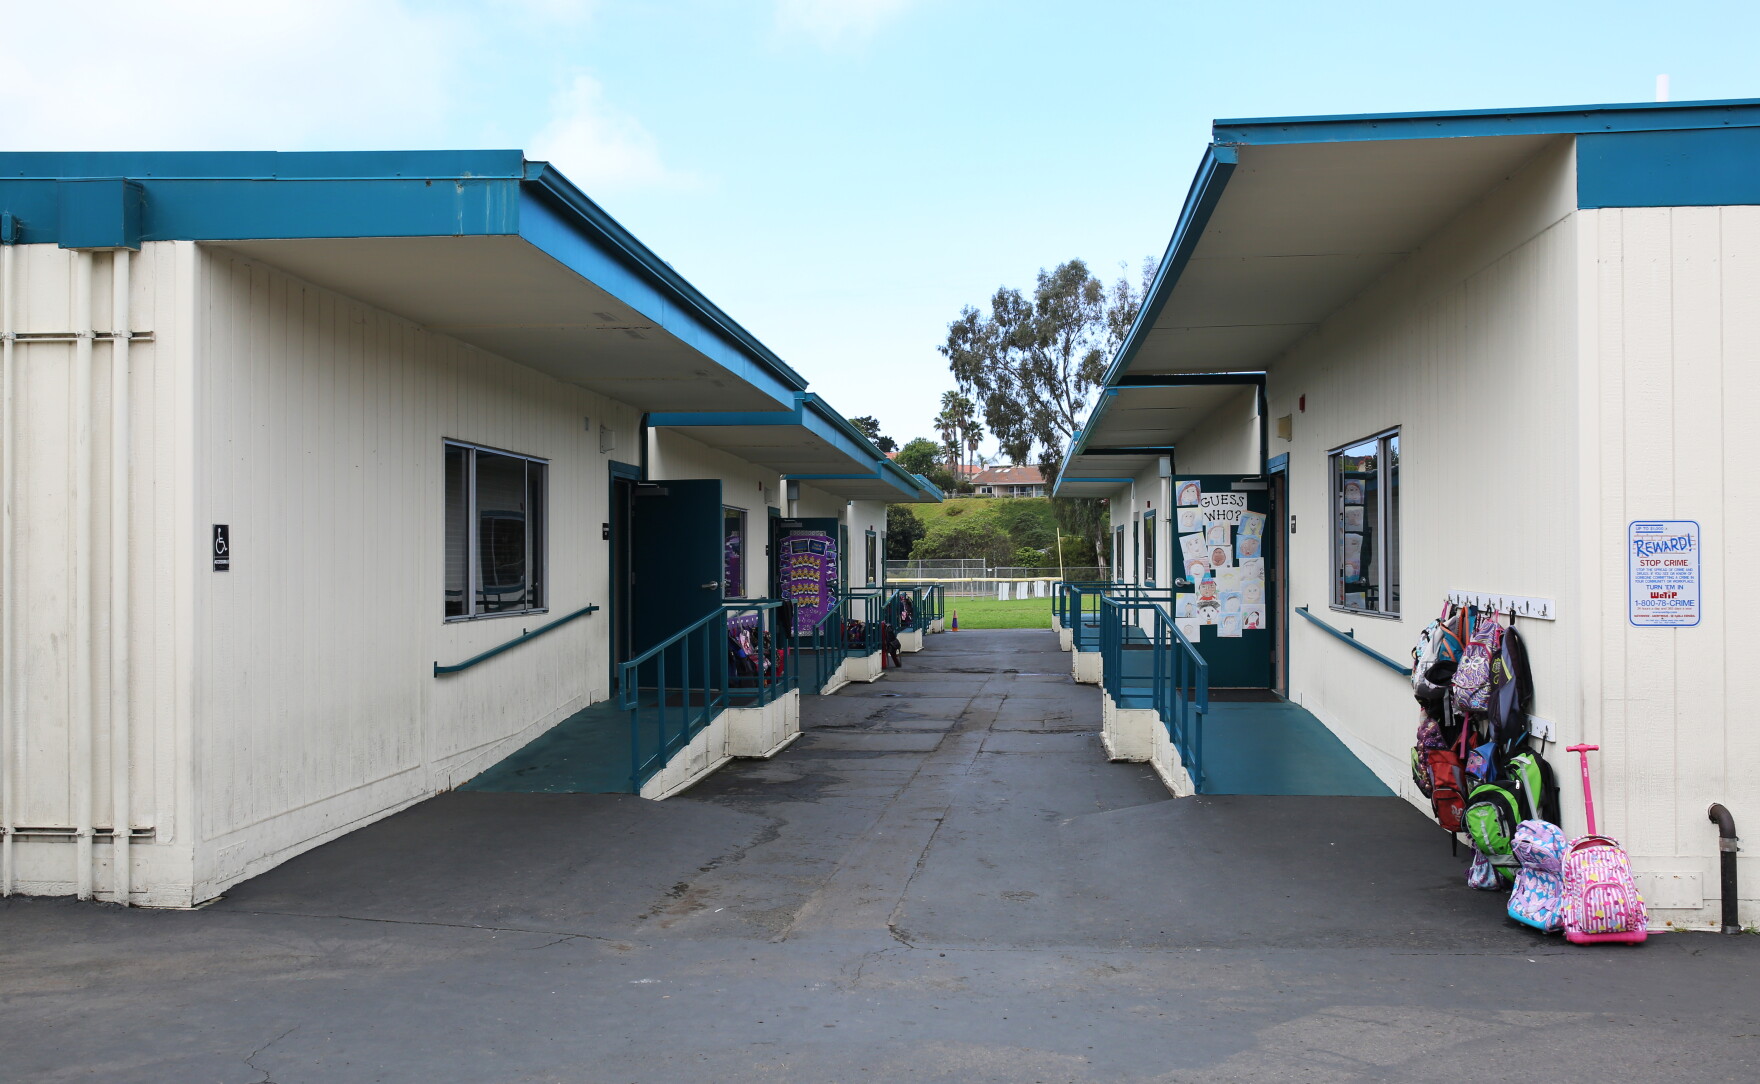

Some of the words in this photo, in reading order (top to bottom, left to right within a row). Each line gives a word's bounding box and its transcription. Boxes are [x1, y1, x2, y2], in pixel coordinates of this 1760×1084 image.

[1200, 494, 1244, 508] GUESS
[1203, 509, 1242, 521] WHO?
[1633, 533, 1692, 557] REWARD!
[1640, 559, 1661, 567] STOP
[1663, 559, 1689, 567] CRIME
